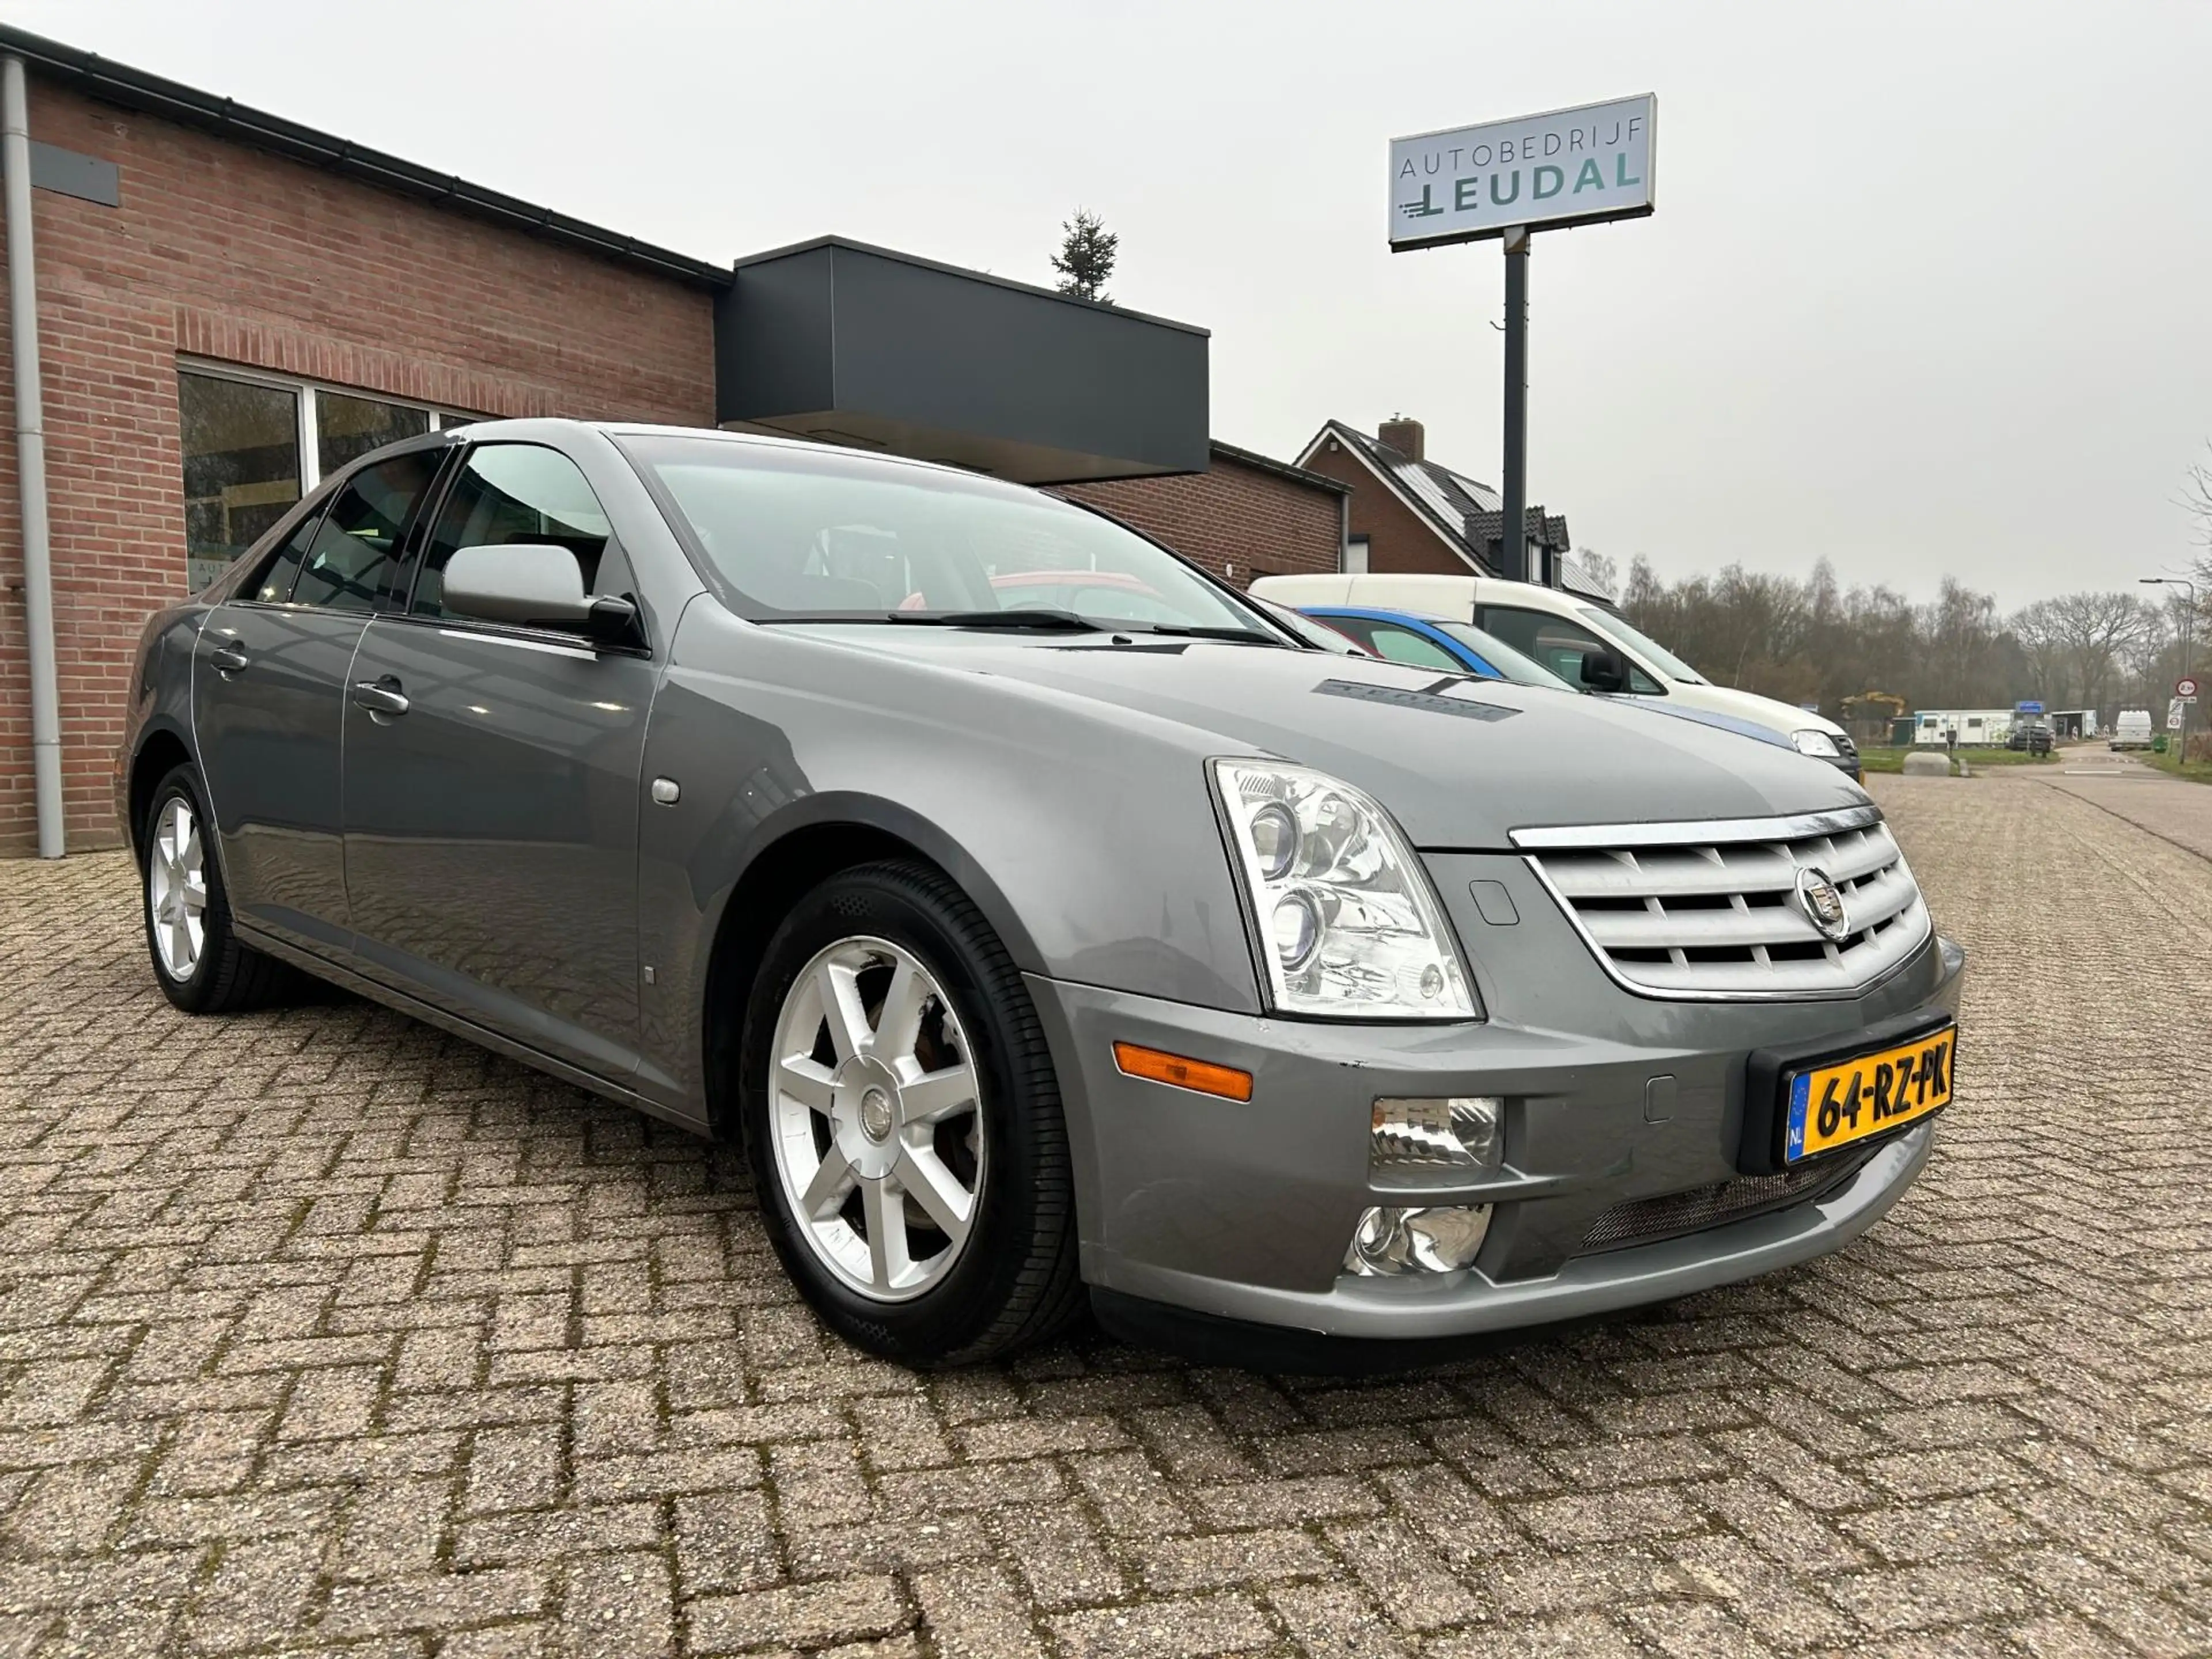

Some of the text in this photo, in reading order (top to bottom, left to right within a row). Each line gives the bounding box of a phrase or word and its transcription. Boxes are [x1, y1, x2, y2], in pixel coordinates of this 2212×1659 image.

[1399, 118, 1642, 179] AUTOBEDRIJF
[1420, 153, 1640, 217] LEUDAL
[1818, 1041, 1948, 1137] 64-RZ-PK
[1790, 1127, 1802, 1146] NL
